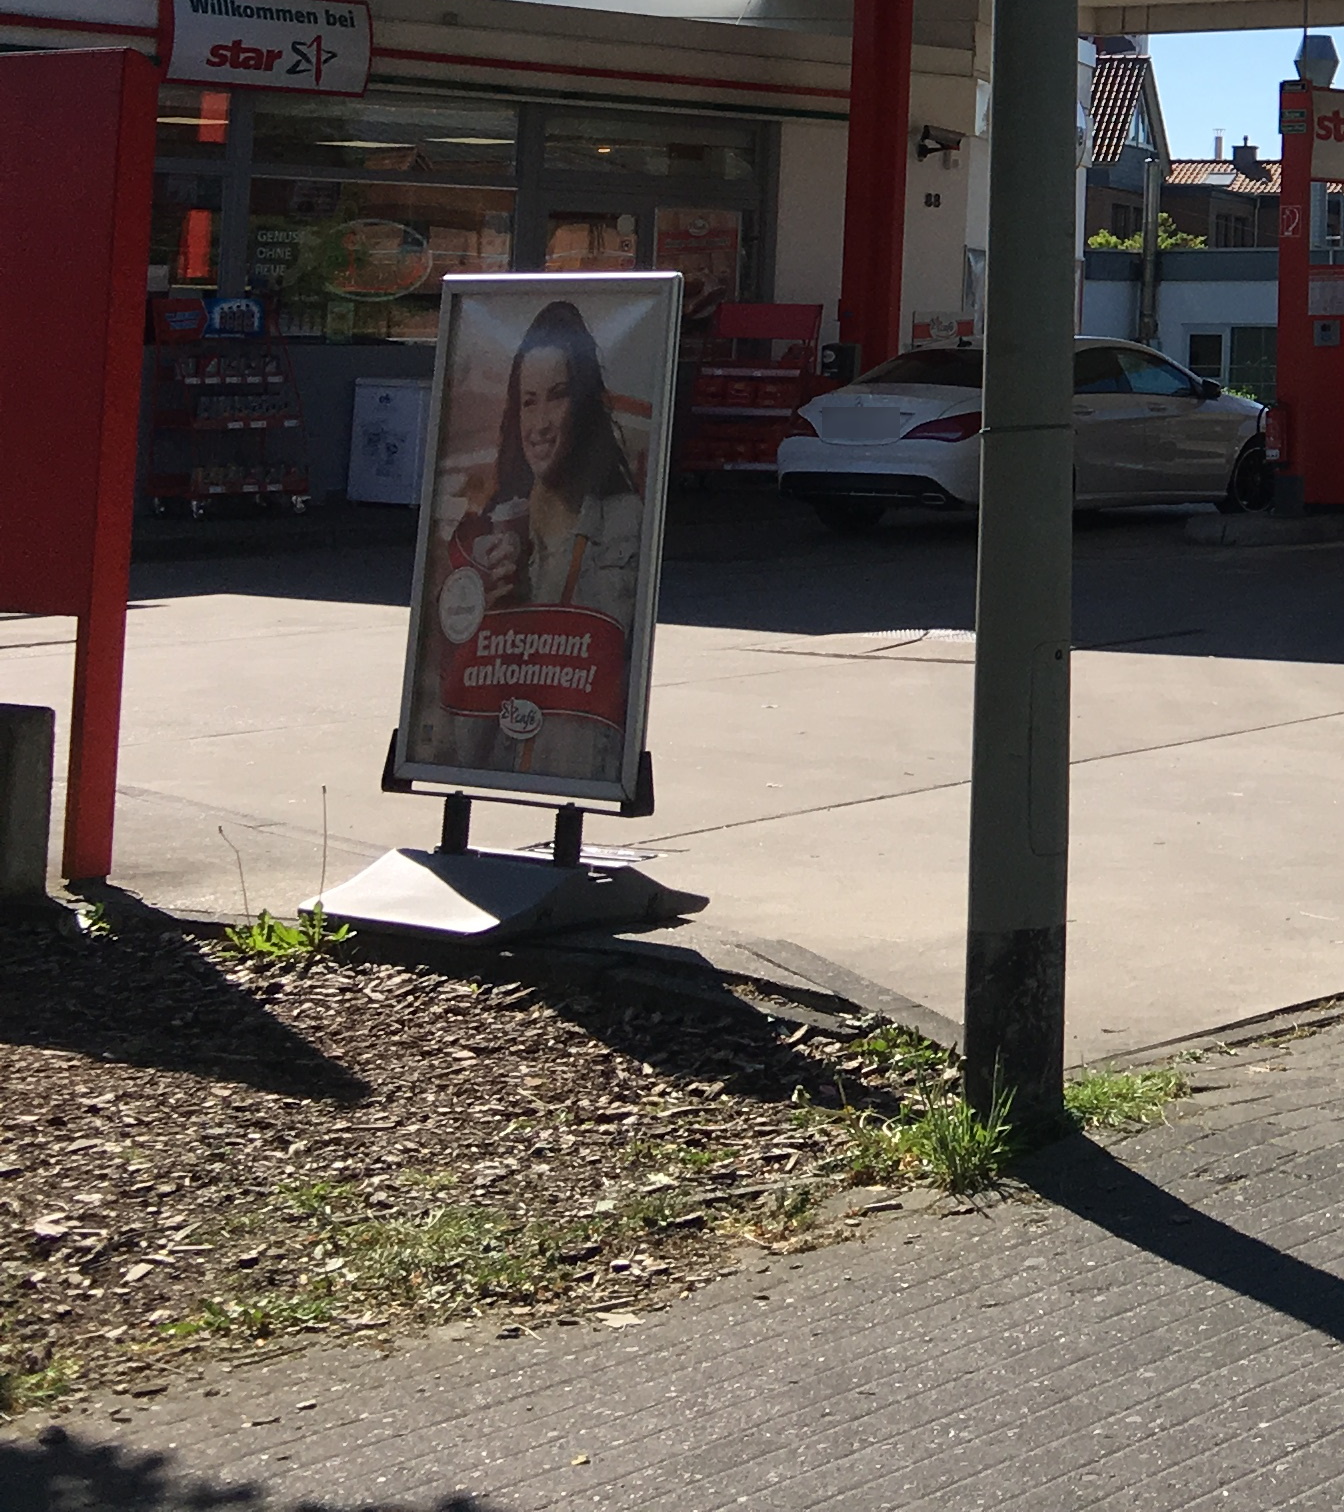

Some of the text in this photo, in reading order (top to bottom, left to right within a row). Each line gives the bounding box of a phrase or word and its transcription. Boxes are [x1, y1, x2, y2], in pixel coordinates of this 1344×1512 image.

[323, 6, 356, 30] bei
[206, 38, 284, 74] star
[476, 628, 592, 660] Entspannt
[463, 658, 598, 694] ankommen!
